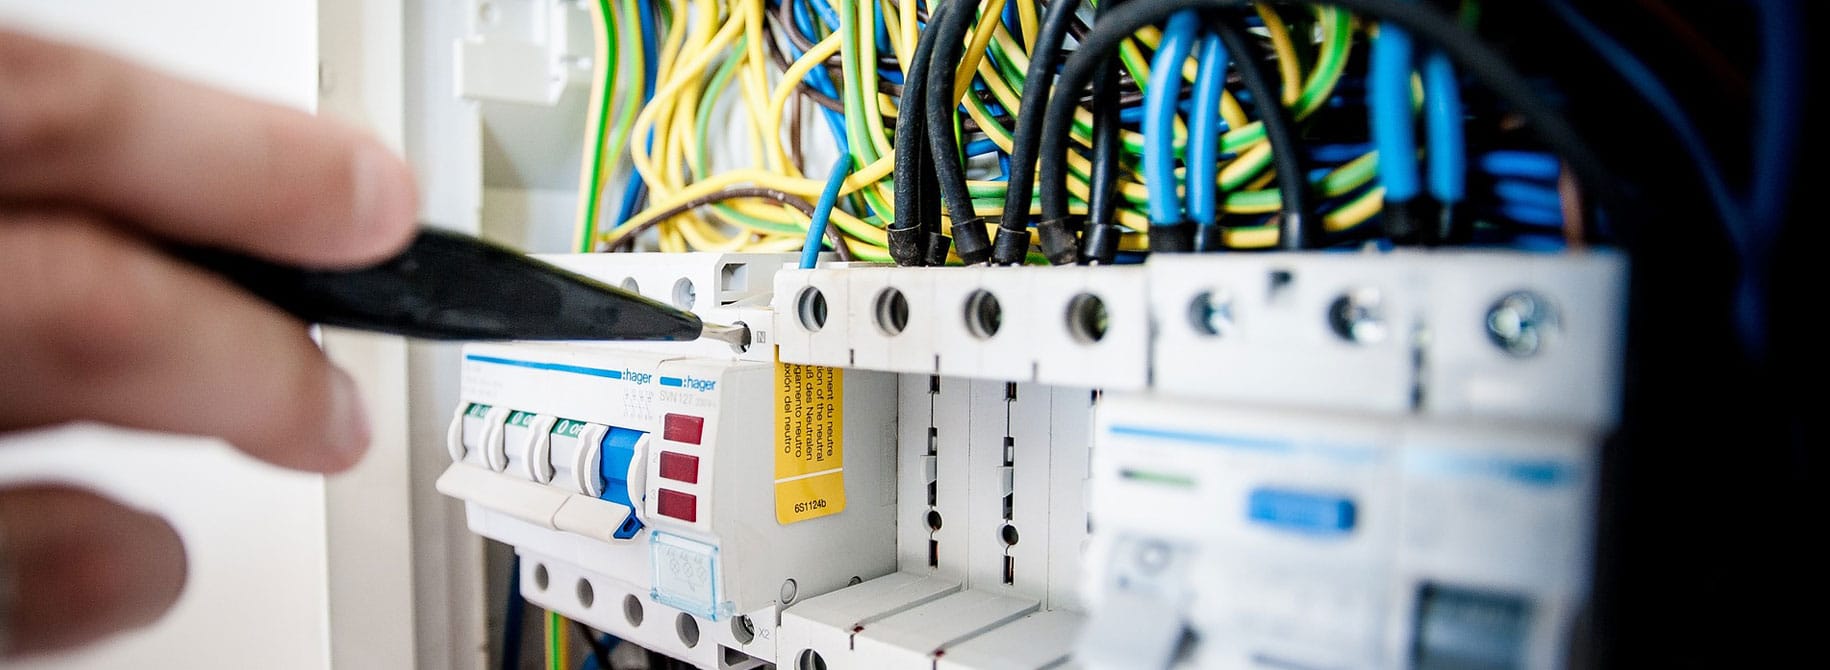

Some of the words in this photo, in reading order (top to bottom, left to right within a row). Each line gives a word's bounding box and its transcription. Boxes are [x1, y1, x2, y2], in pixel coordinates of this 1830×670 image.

[805, 382, 814, 403] des
[816, 388, 825, 400] of
[784, 395, 792, 413] del
[816, 402, 825, 420] the
[826, 403, 834, 418] du
[557, 419, 569, 433] 0
[784, 416, 792, 454] neutro
[805, 406, 814, 461] Neutralen
[795, 421, 803, 458] neutro
[816, 423, 825, 462] neutral
[826, 421, 834, 456] neutre
[794, 499, 827, 513] 6S1124b
[758, 627, 770, 640] X2
